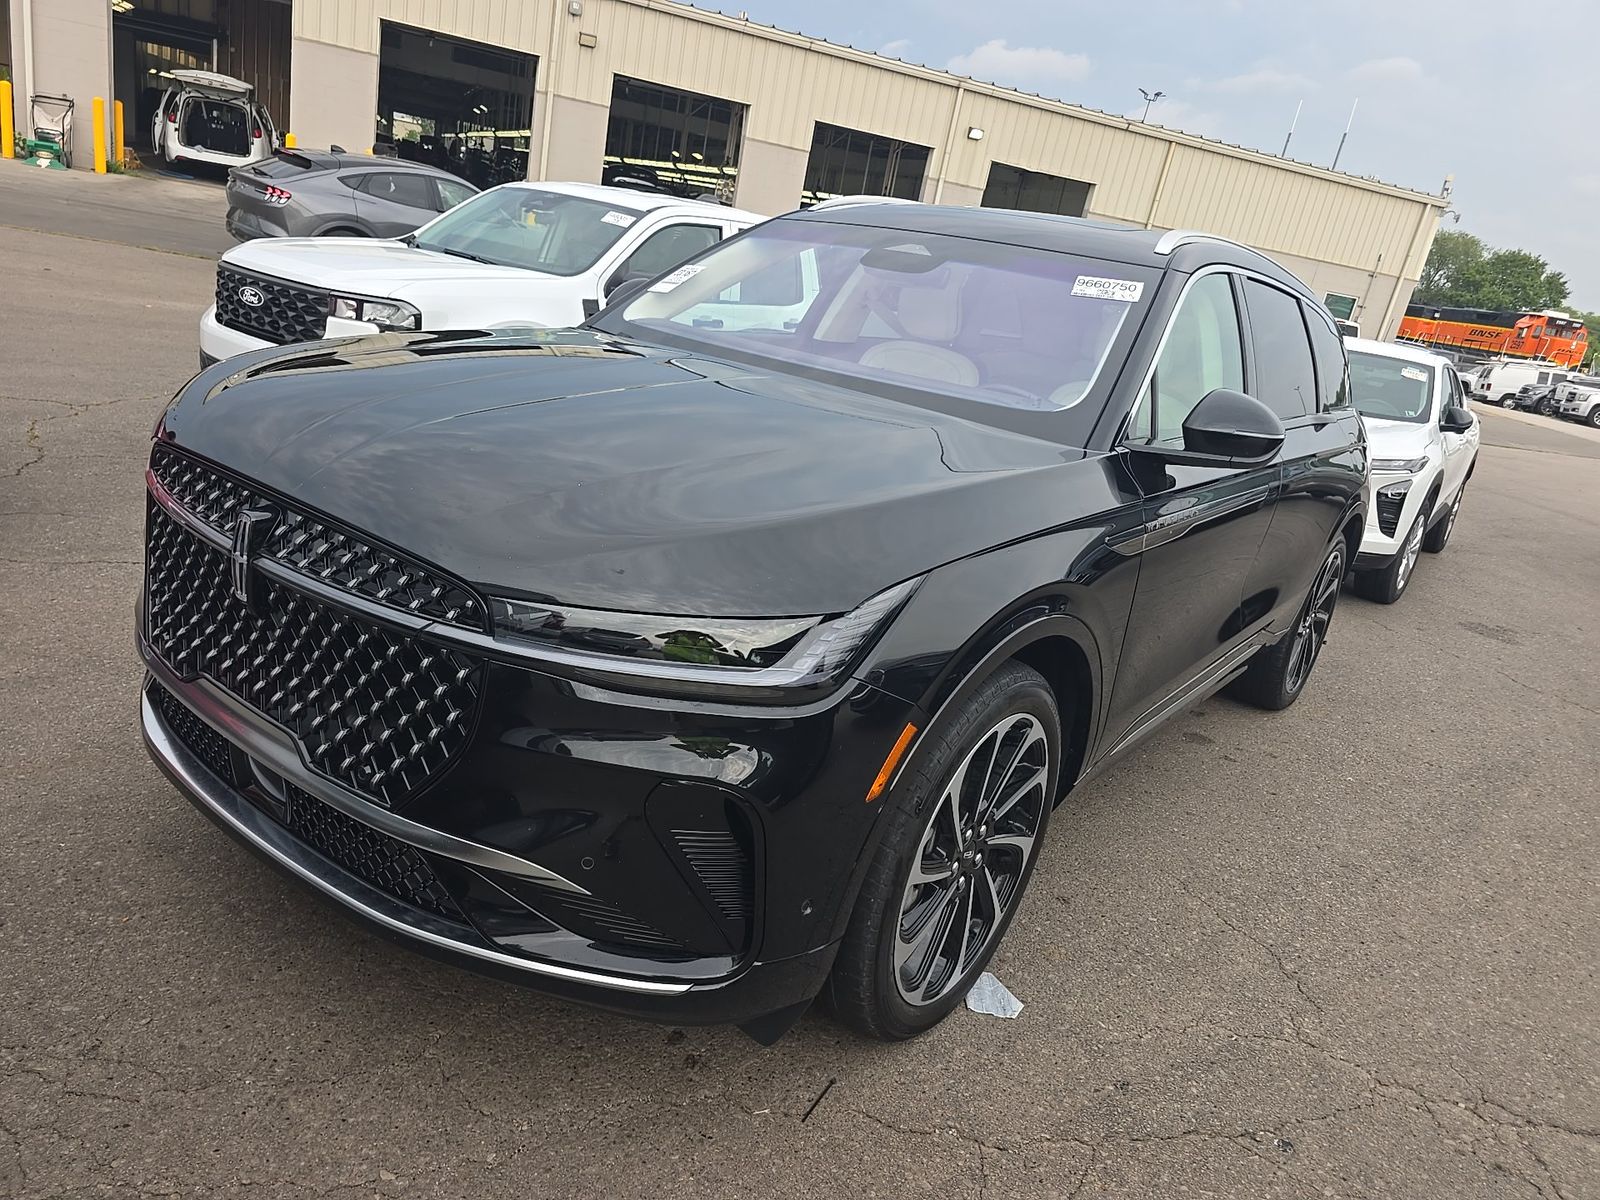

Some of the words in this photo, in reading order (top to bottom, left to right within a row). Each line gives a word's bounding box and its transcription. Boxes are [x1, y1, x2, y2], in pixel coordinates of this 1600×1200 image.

[1077, 278, 1137, 292] 9660750
[243, 288, 259, 304] Ford
[1469, 329, 1503, 339] BNSF
